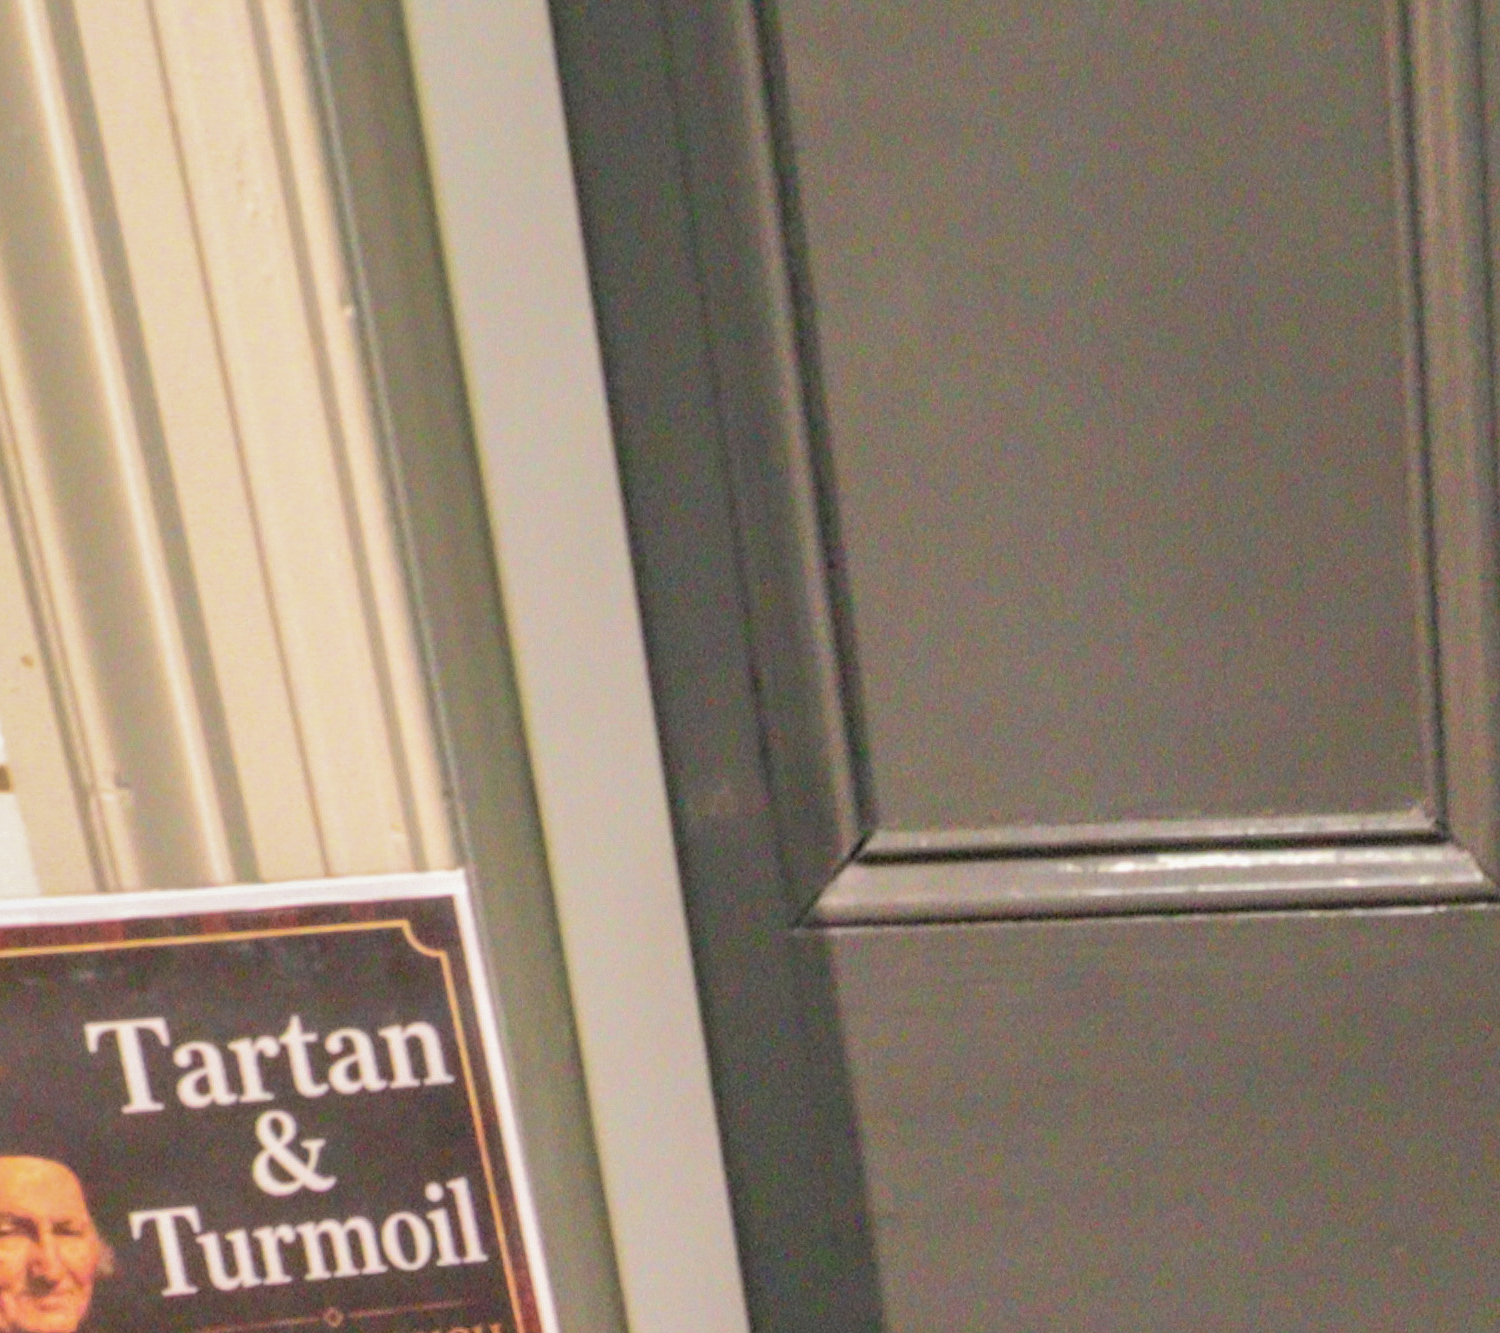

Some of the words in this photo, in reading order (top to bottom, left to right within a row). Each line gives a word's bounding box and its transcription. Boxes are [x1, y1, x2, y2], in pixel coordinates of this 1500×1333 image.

[84, 1014, 455, 1114] Tartan
[252, 1110, 336, 1196] &
[128, 1176, 489, 1297] Turmoil
